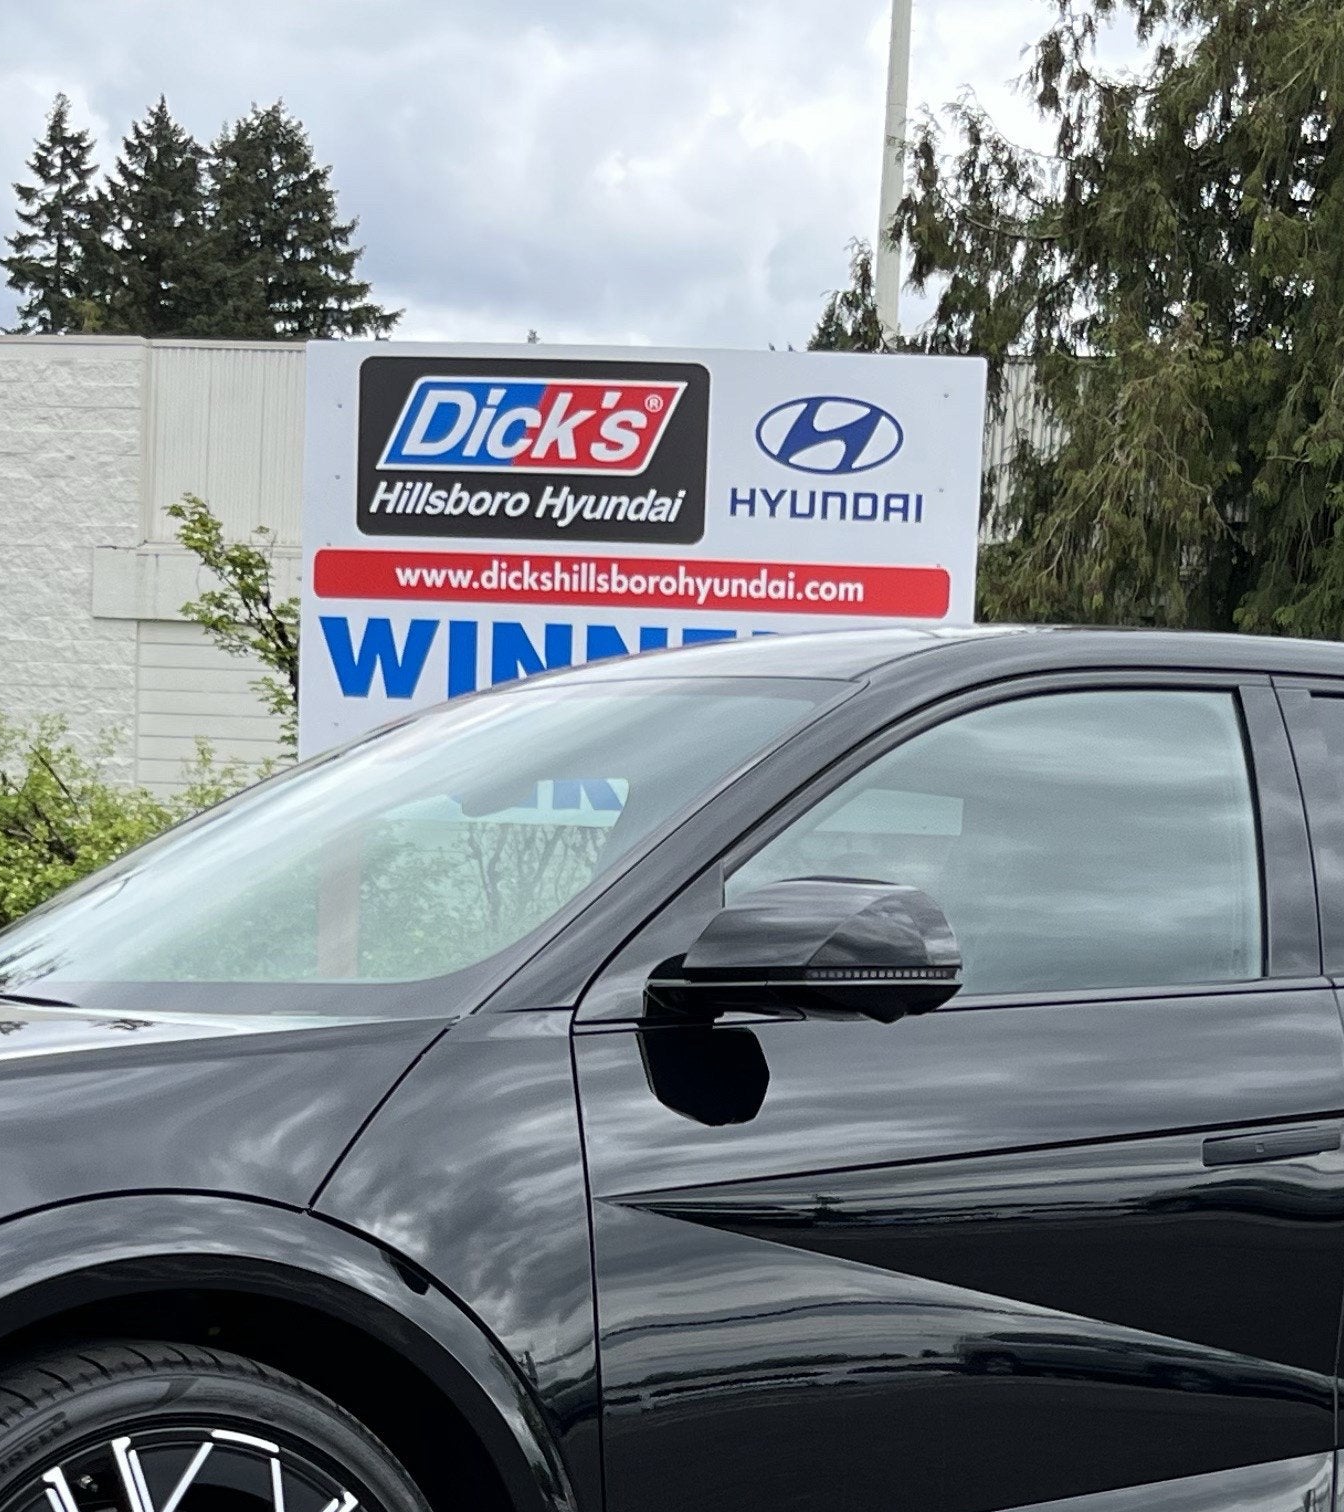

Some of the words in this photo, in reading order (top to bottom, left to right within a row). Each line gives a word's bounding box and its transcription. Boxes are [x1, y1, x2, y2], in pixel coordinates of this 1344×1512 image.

[368, 480, 531, 519] Hillsboro
[534, 485, 687, 528] Hyundai
[728, 487, 924, 523] HYUNDAI
[394, 559, 865, 606] www.dickshillsborohyundai.com
